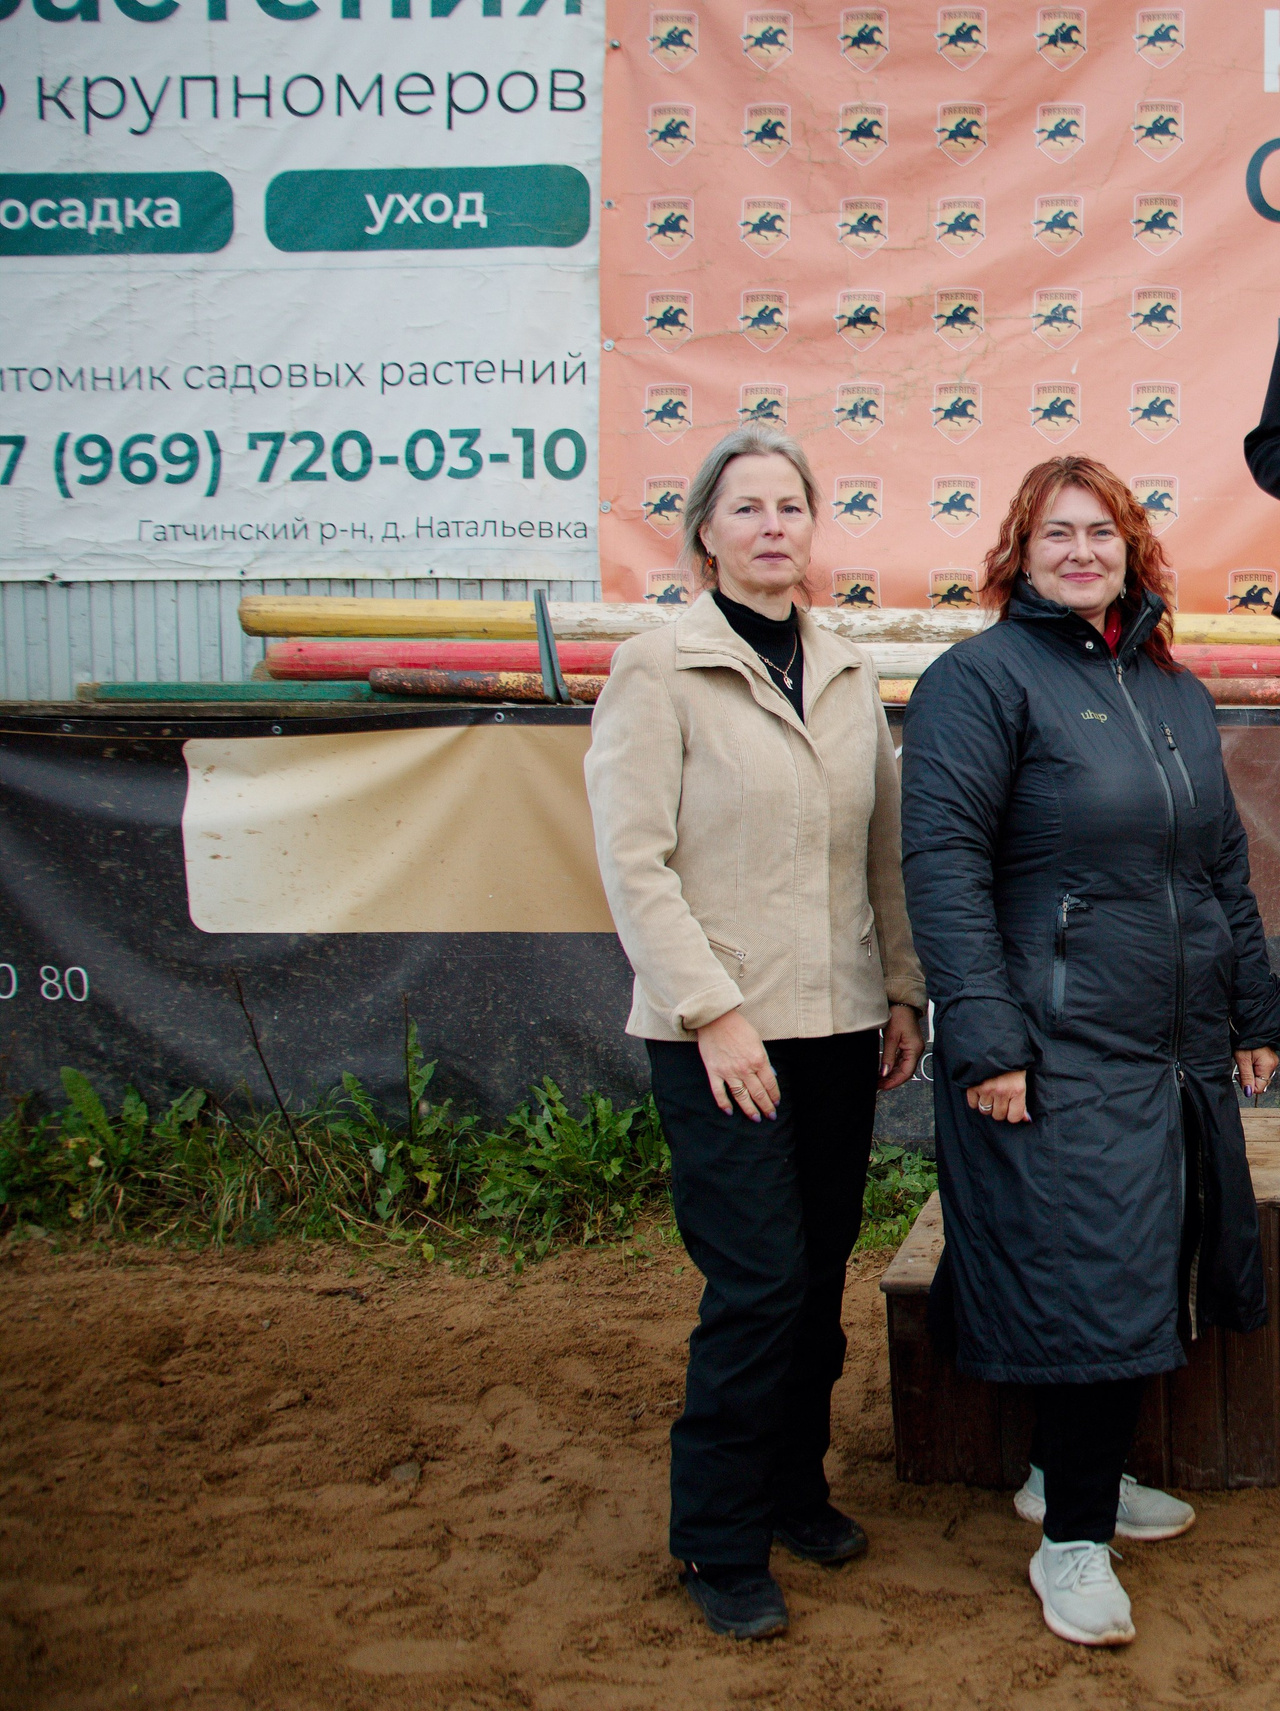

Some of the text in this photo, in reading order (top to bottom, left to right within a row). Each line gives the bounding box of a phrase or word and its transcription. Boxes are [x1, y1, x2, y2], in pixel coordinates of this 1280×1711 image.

[36, 69, 588, 136] крупномеров
[364, 190, 489, 235] уход
[183, 360, 366, 395] садовых
[380, 352, 588, 395] растений
[54, 430, 222, 499] (969)
[247, 427, 588, 483] 720-03-10
[138, 515, 589, 546] Гатчинский р-н, д. Натальевка
[40, 965, 90, 1002] 80
